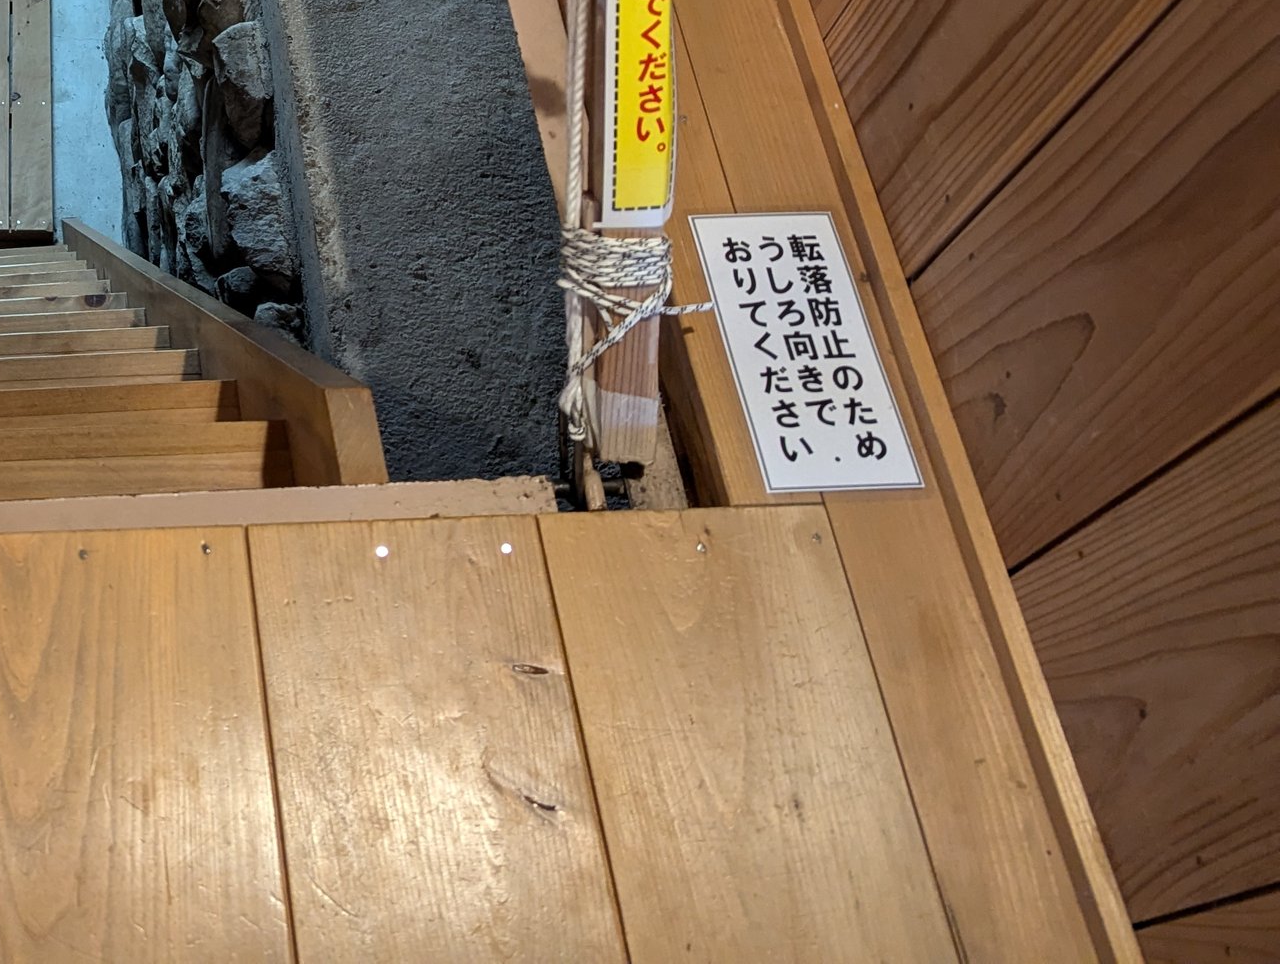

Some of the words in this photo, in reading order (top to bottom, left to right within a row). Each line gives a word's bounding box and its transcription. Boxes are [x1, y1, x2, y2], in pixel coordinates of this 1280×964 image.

[722, 237, 814, 463] おりてください
[786, 234, 887, 461] 転落防止のため
